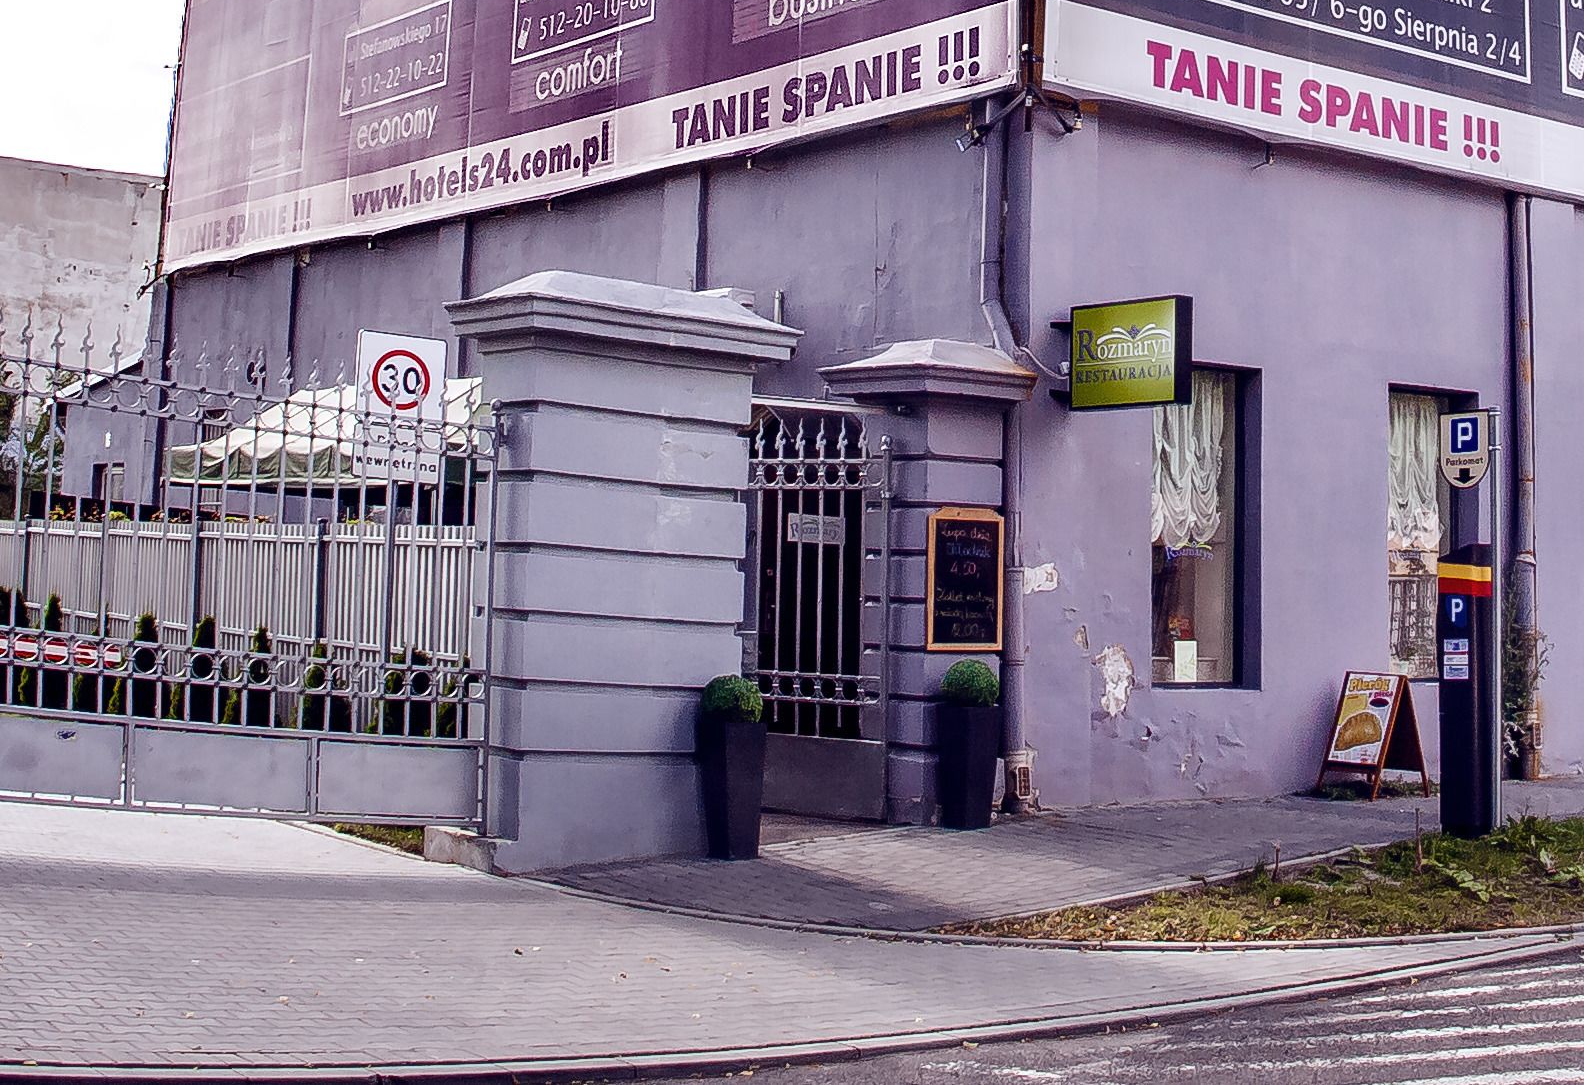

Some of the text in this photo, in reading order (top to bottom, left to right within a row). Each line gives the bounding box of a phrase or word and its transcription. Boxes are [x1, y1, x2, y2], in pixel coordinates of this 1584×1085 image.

[435, 14, 447, 35] 17
[1394, 6, 1479, 60] Sierpnia
[1485, 32, 1521, 68] 2/4
[360, 52, 444, 97] 512-22-10-22
[535, 39, 623, 100] comfort
[672, 25, 980, 150] TANIE SPANIE !!!
[1146, 39, 1501, 164] TANIE SPANIE !!!
[356, 104, 439, 149] economy
[351, 120, 611, 218] www.hotels24.com.pl
[1076, 328, 1172, 363] Rozmaryn
[381, 363, 421, 395] 30
[1075, 363, 1171, 384] RESTAURACJA
[1457, 421, 1472, 449] P
[1445, 456, 1484, 467] Parkomat
[1451, 597, 1464, 623] P
